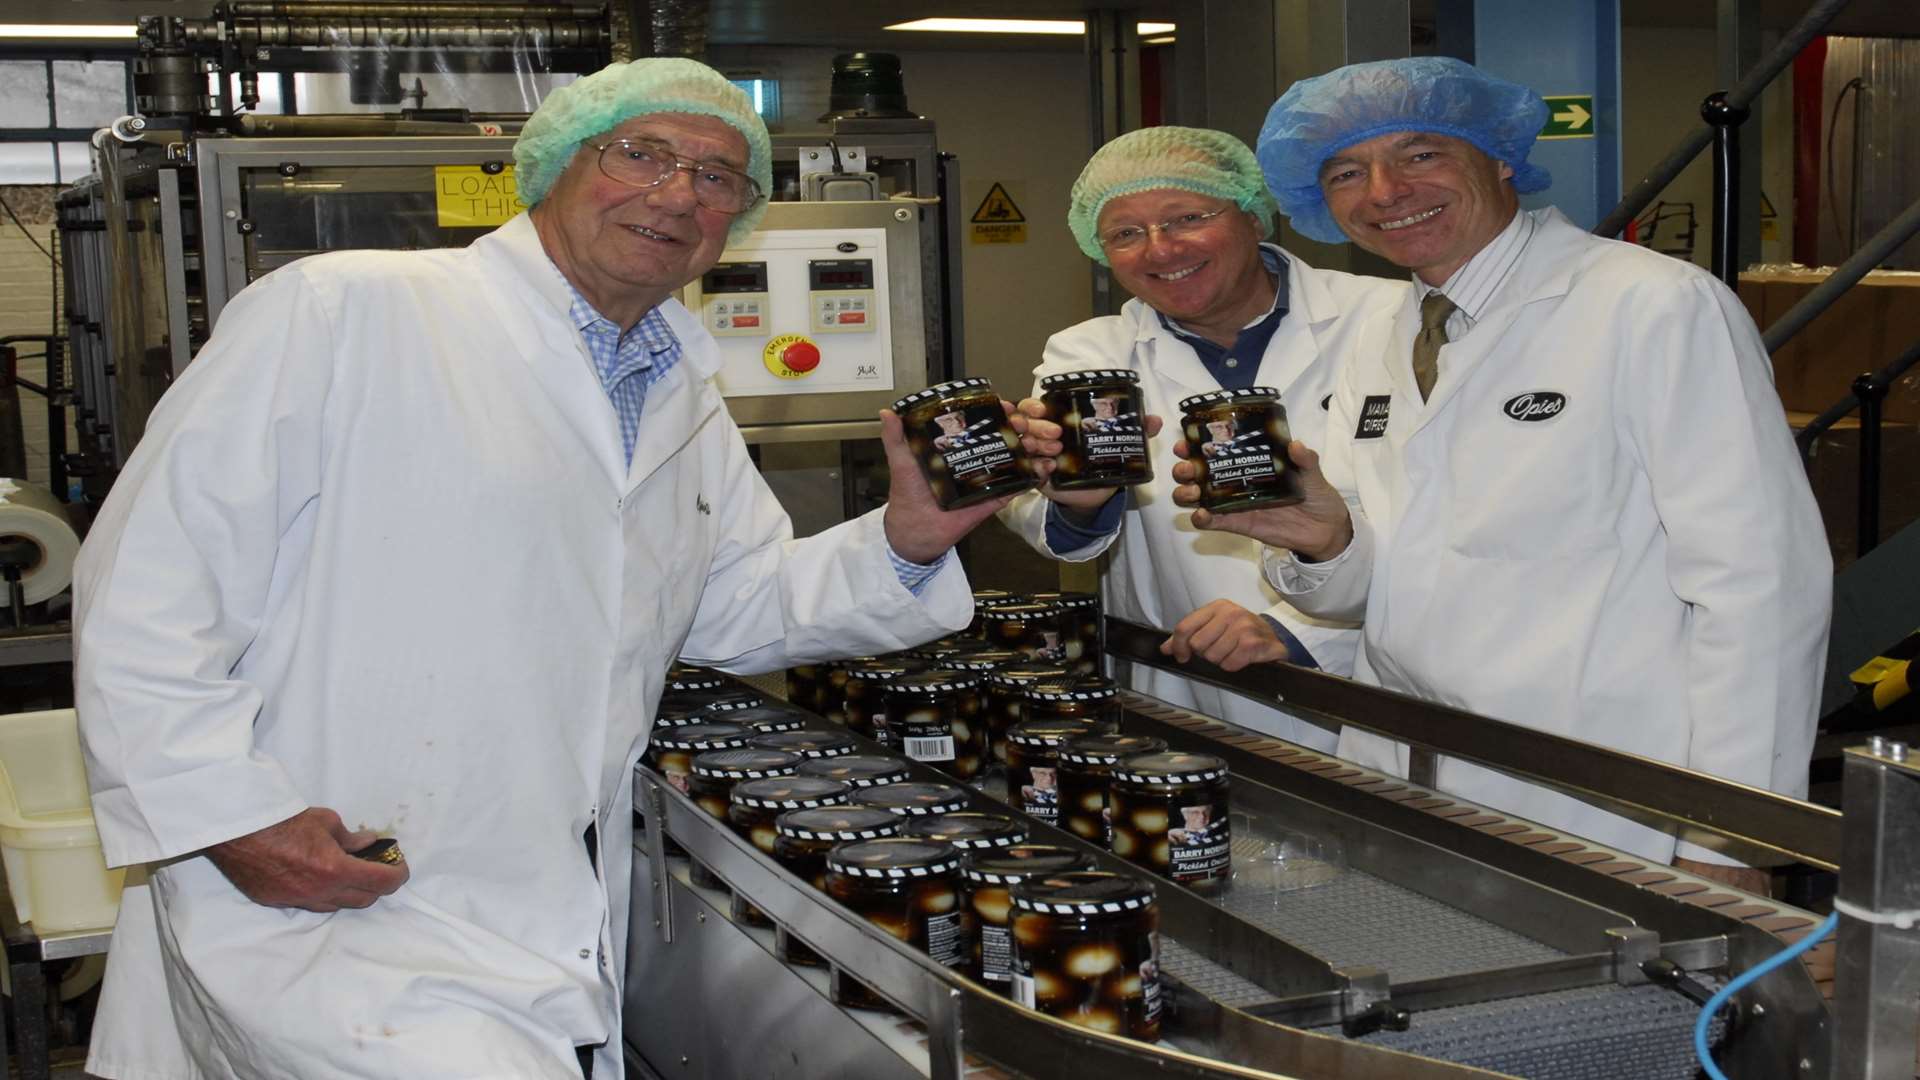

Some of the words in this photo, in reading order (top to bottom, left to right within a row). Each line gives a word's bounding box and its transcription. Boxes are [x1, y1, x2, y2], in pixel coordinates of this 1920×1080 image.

[464, 198, 529, 217] THIS
[976, 224, 1021, 233] DANGER
[766, 336, 808, 355] EMERGEN
[1366, 403, 1390, 416] MANA
[1510, 394, 1562, 421] Opies
[1363, 418, 1389, 432] DIREC
[1088, 436, 1114, 444] BARRY
[945, 449, 972, 462] BARRY
[972, 441, 1006, 453] NORMAN
[1093, 446, 1121, 454] Pickled
[955, 458, 984, 472] Pickled
[984, 453, 1011, 463] Onions
[1209, 458, 1233, 469] BARRY
[1234, 454, 1271, 464] NORMAN
[1214, 469, 1242, 480] Pickled
[1244, 466, 1273, 475] Onions
[1025, 807, 1050, 815] BARRY
[1174, 849, 1203, 859] BARRY
[1178, 860, 1209, 870] Pickled
